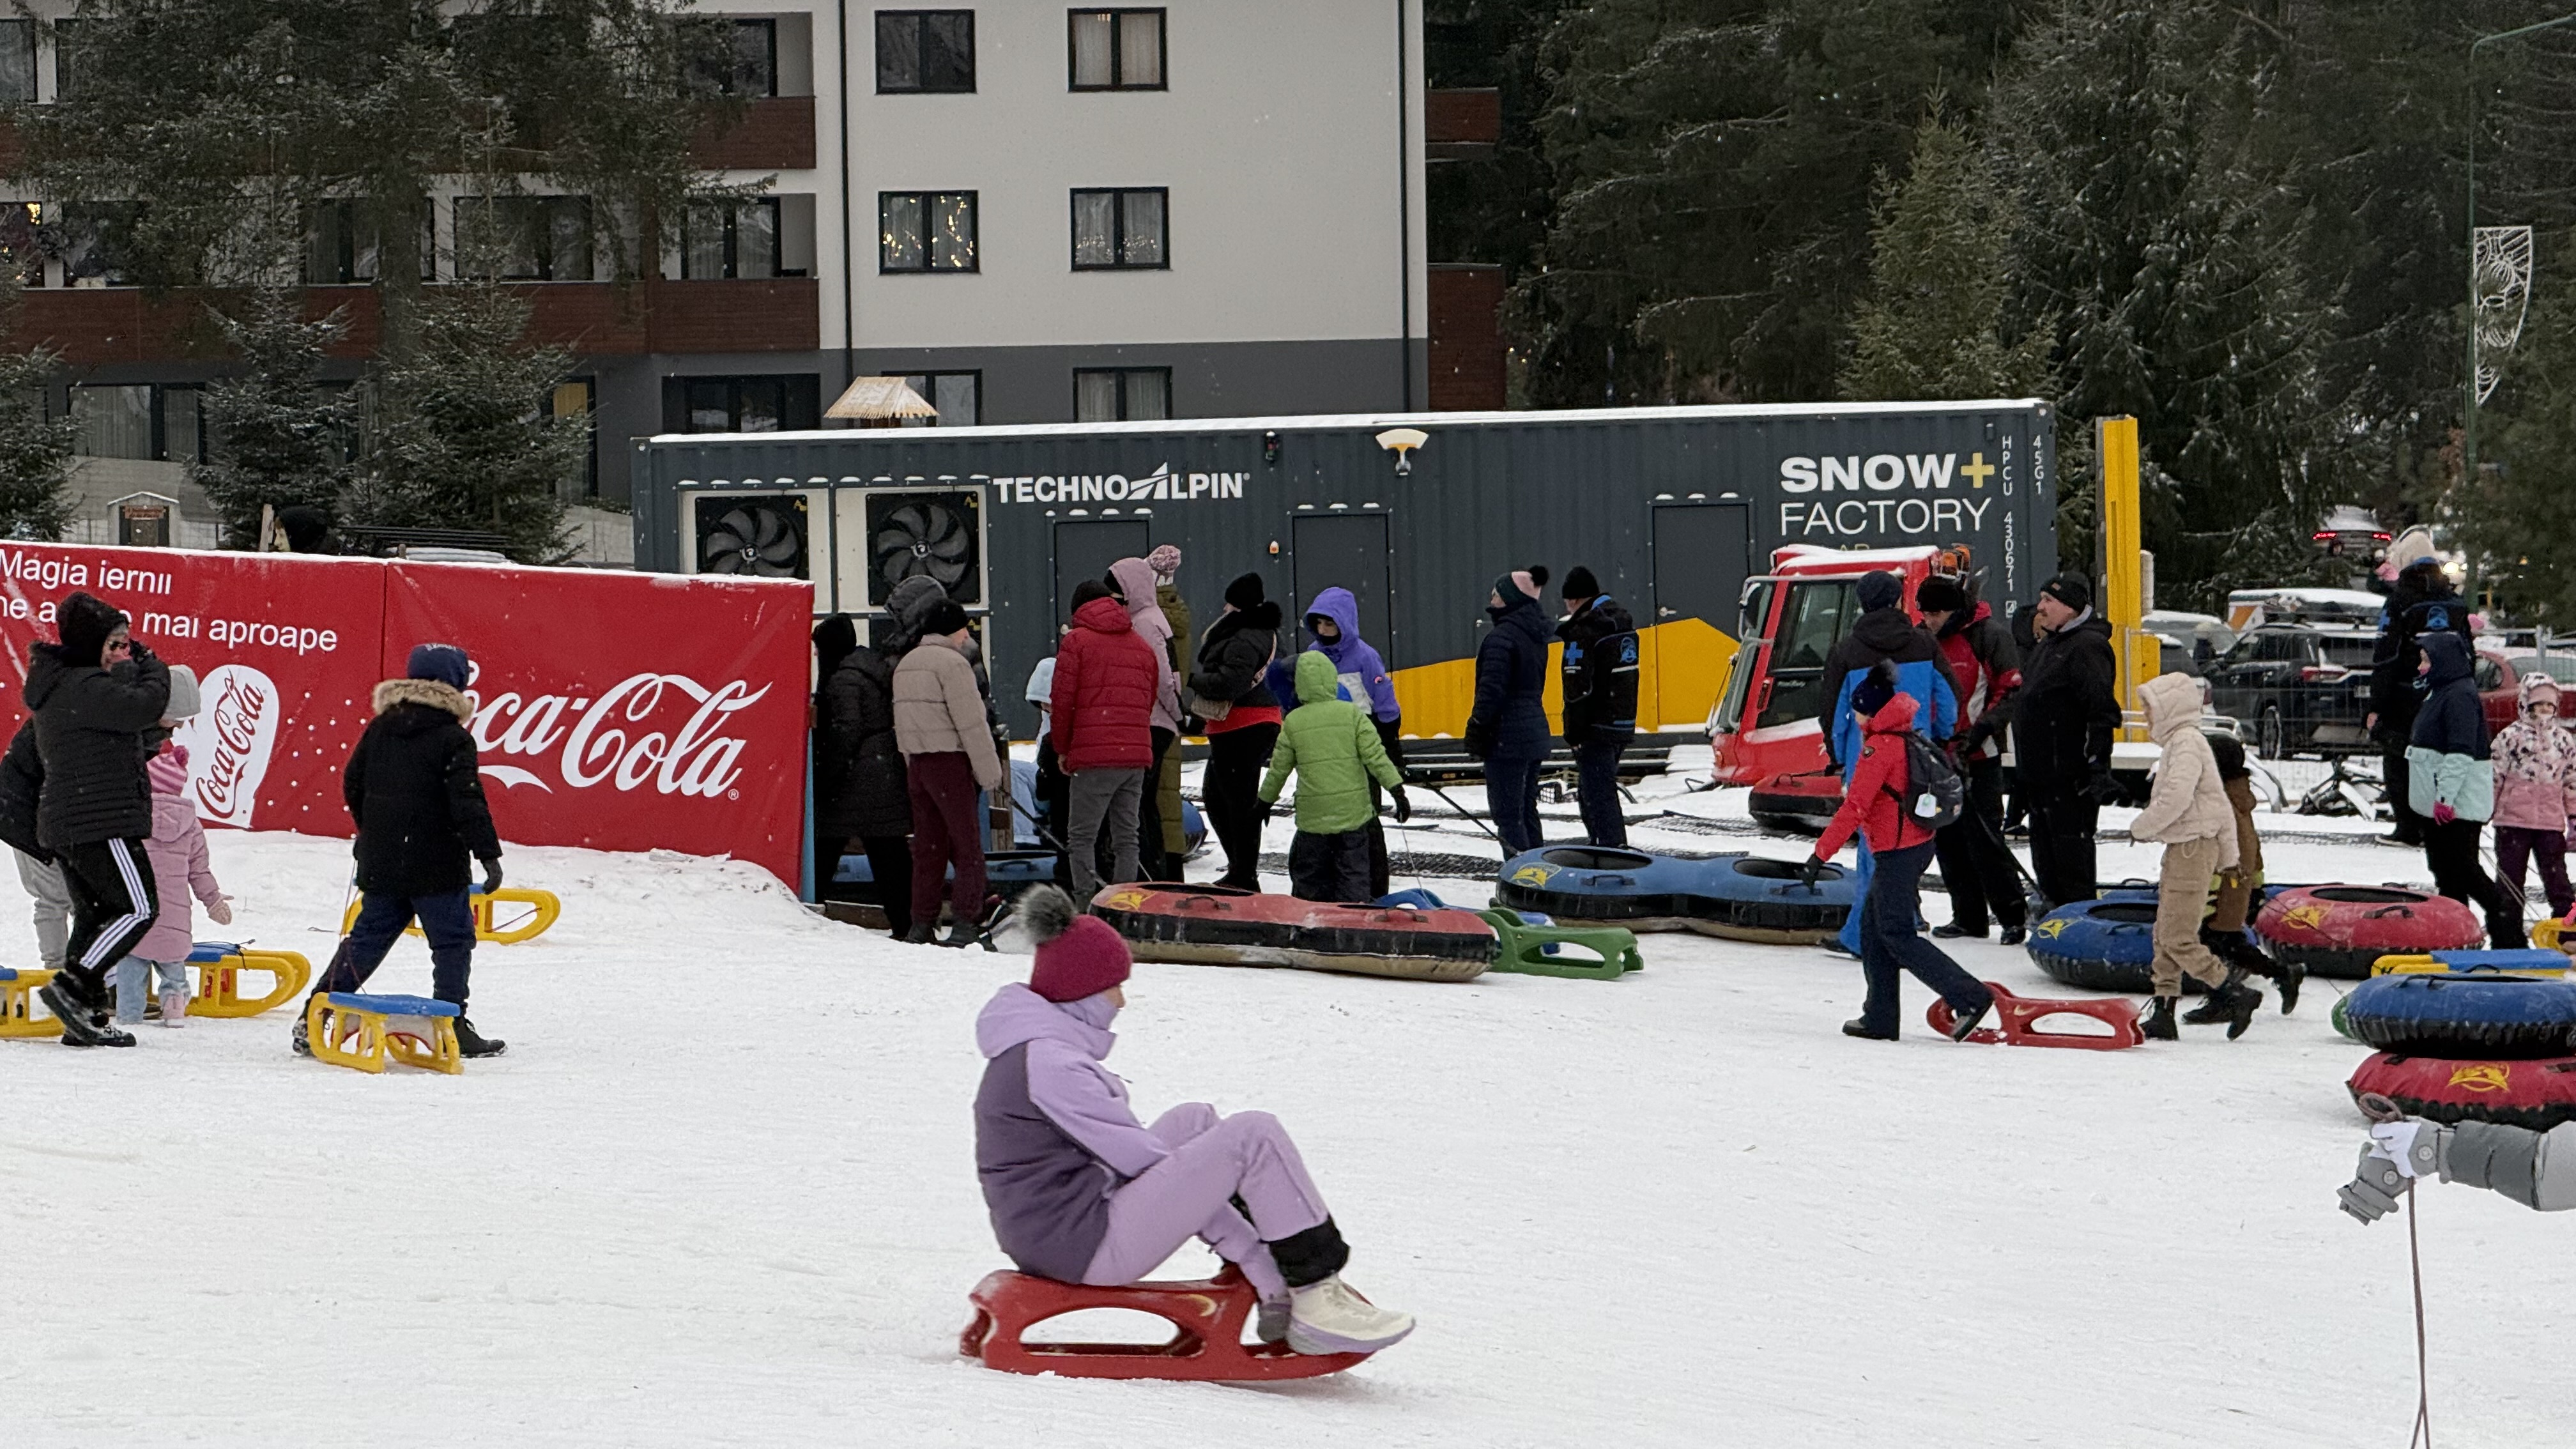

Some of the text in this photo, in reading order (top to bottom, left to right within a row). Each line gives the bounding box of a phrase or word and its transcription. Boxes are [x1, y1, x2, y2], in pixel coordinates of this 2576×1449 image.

[2002, 435, 2013, 496] HPCU
[2033, 435, 2044, 495] 45G1
[1781, 497, 1991, 536] FACTORY
[2004, 510, 2014, 592] 430671
[209, 619, 337, 656] aproape
[195, 668, 264, 818] Coca-Cola
